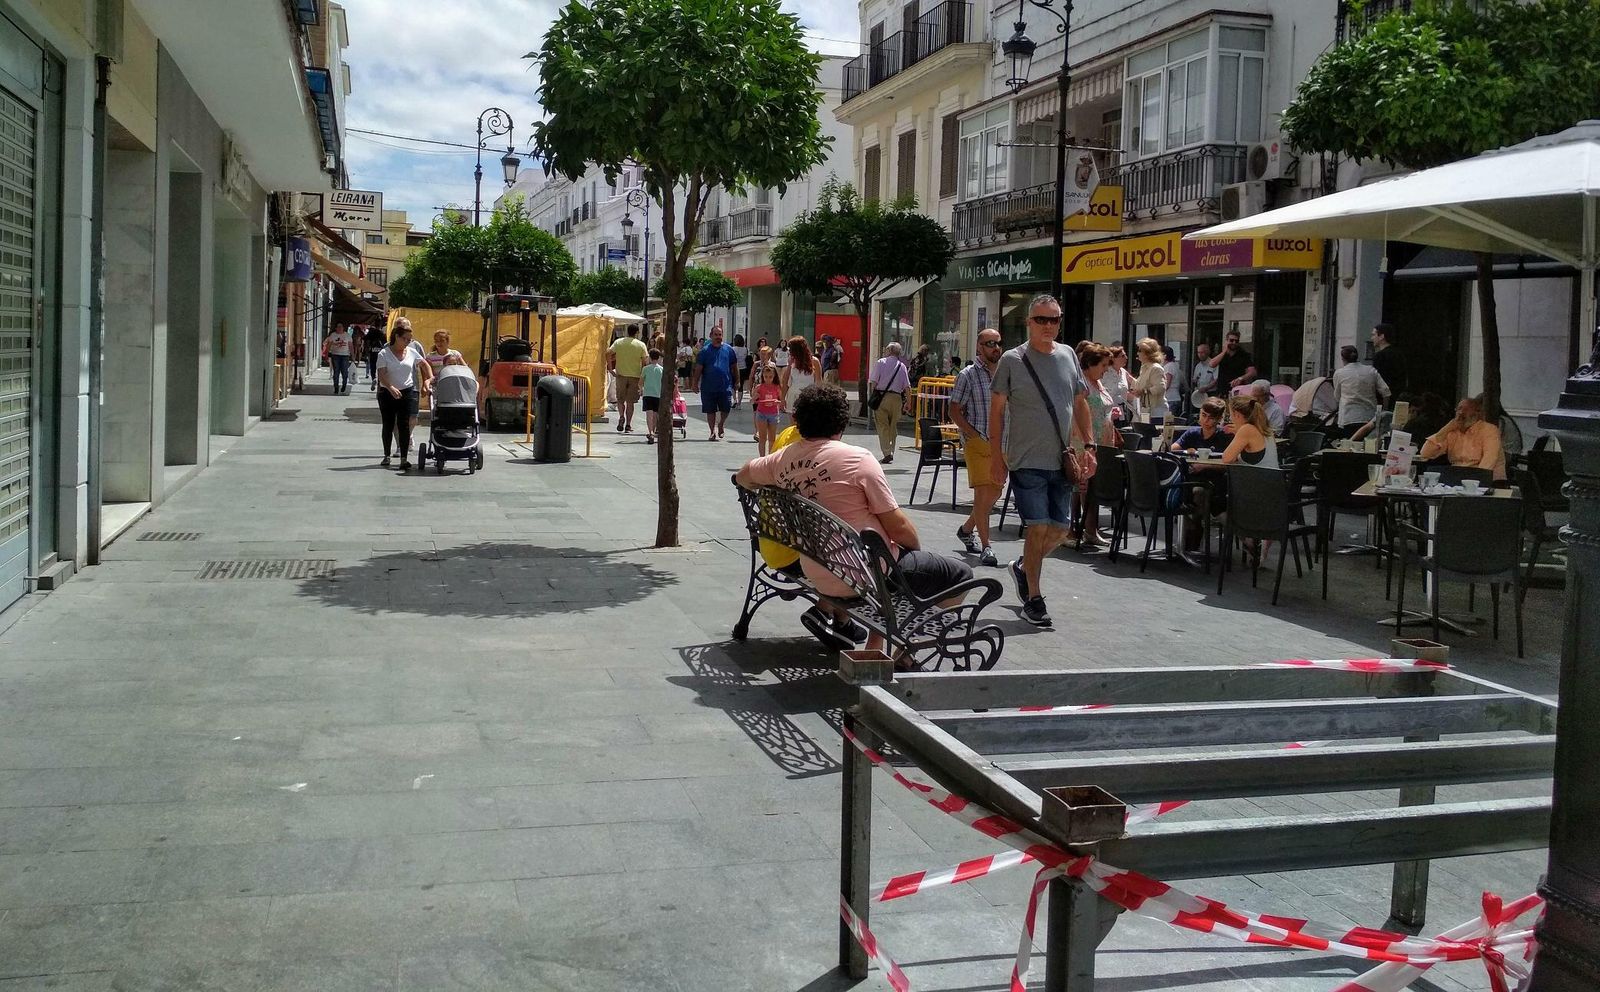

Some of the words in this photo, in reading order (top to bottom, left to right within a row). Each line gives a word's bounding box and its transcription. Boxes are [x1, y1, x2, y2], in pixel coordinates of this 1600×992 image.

[331, 192, 375, 205] LEIRANA
[1200, 252, 1231, 267] claras
[959, 265, 985, 281] VIAJES
